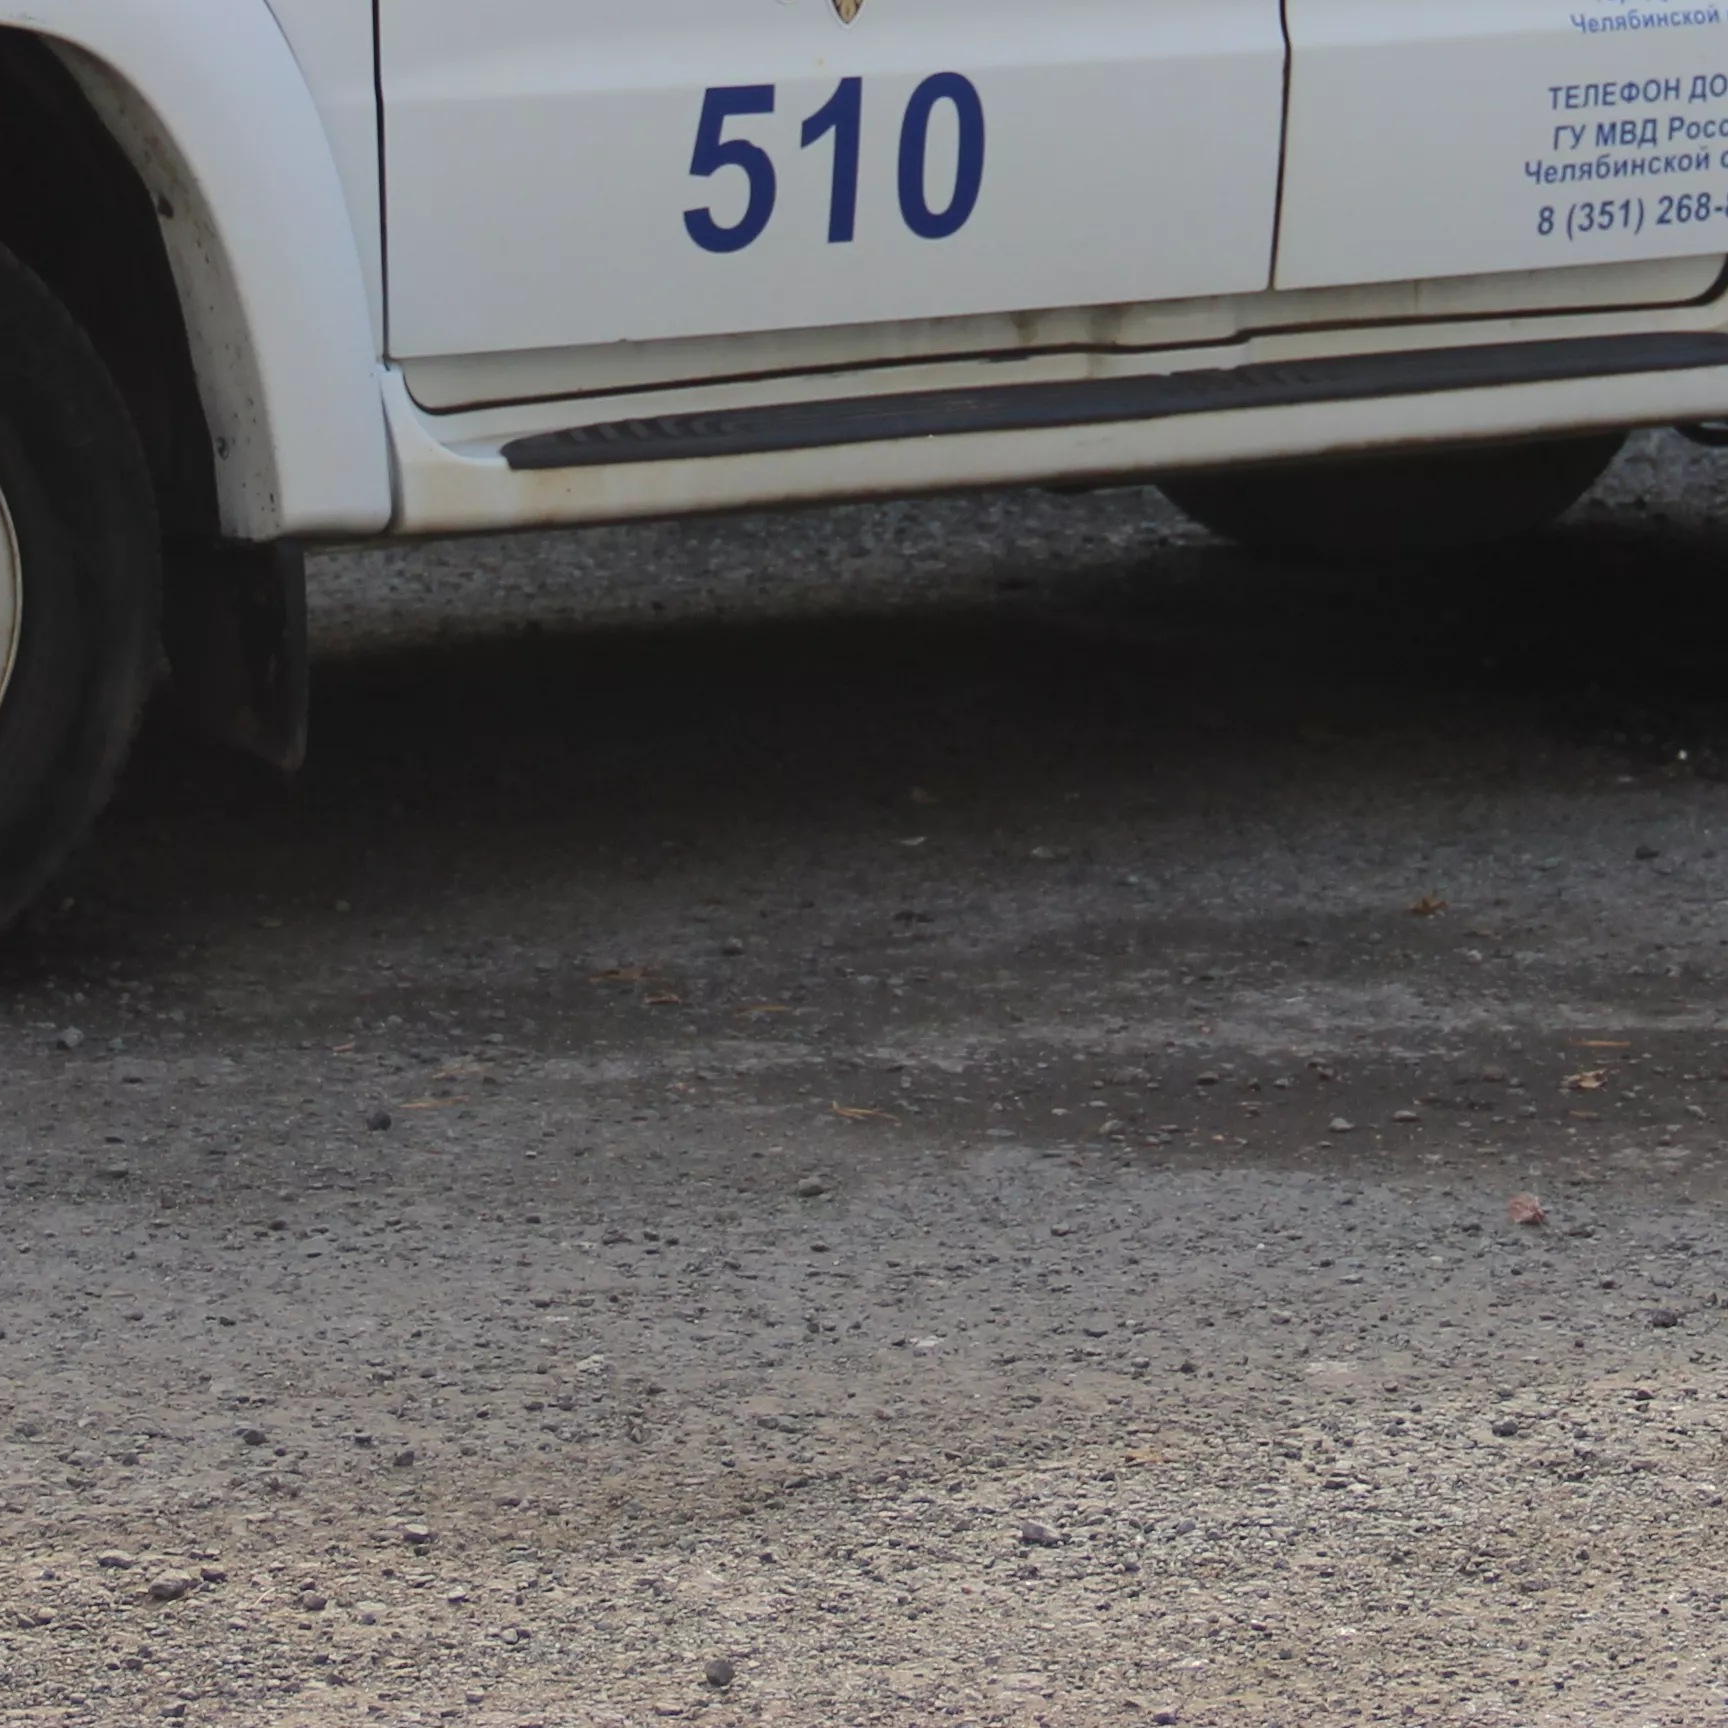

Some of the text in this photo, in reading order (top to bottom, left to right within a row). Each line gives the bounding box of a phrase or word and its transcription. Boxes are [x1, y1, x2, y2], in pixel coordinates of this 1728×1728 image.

[1570, 4, 1720, 35] Челябинской
[1548, 78, 1681, 110] ТЕЛЕФОН
[1553, 124, 1586, 151] ГУ
[1595, 118, 1658, 148] МВД
[683, 72, 986, 254] 510
[1525, 145, 1711, 185] Челябинской
[1537, 206, 1555, 236] 8
[1566, 197, 1645, 241] (351)
